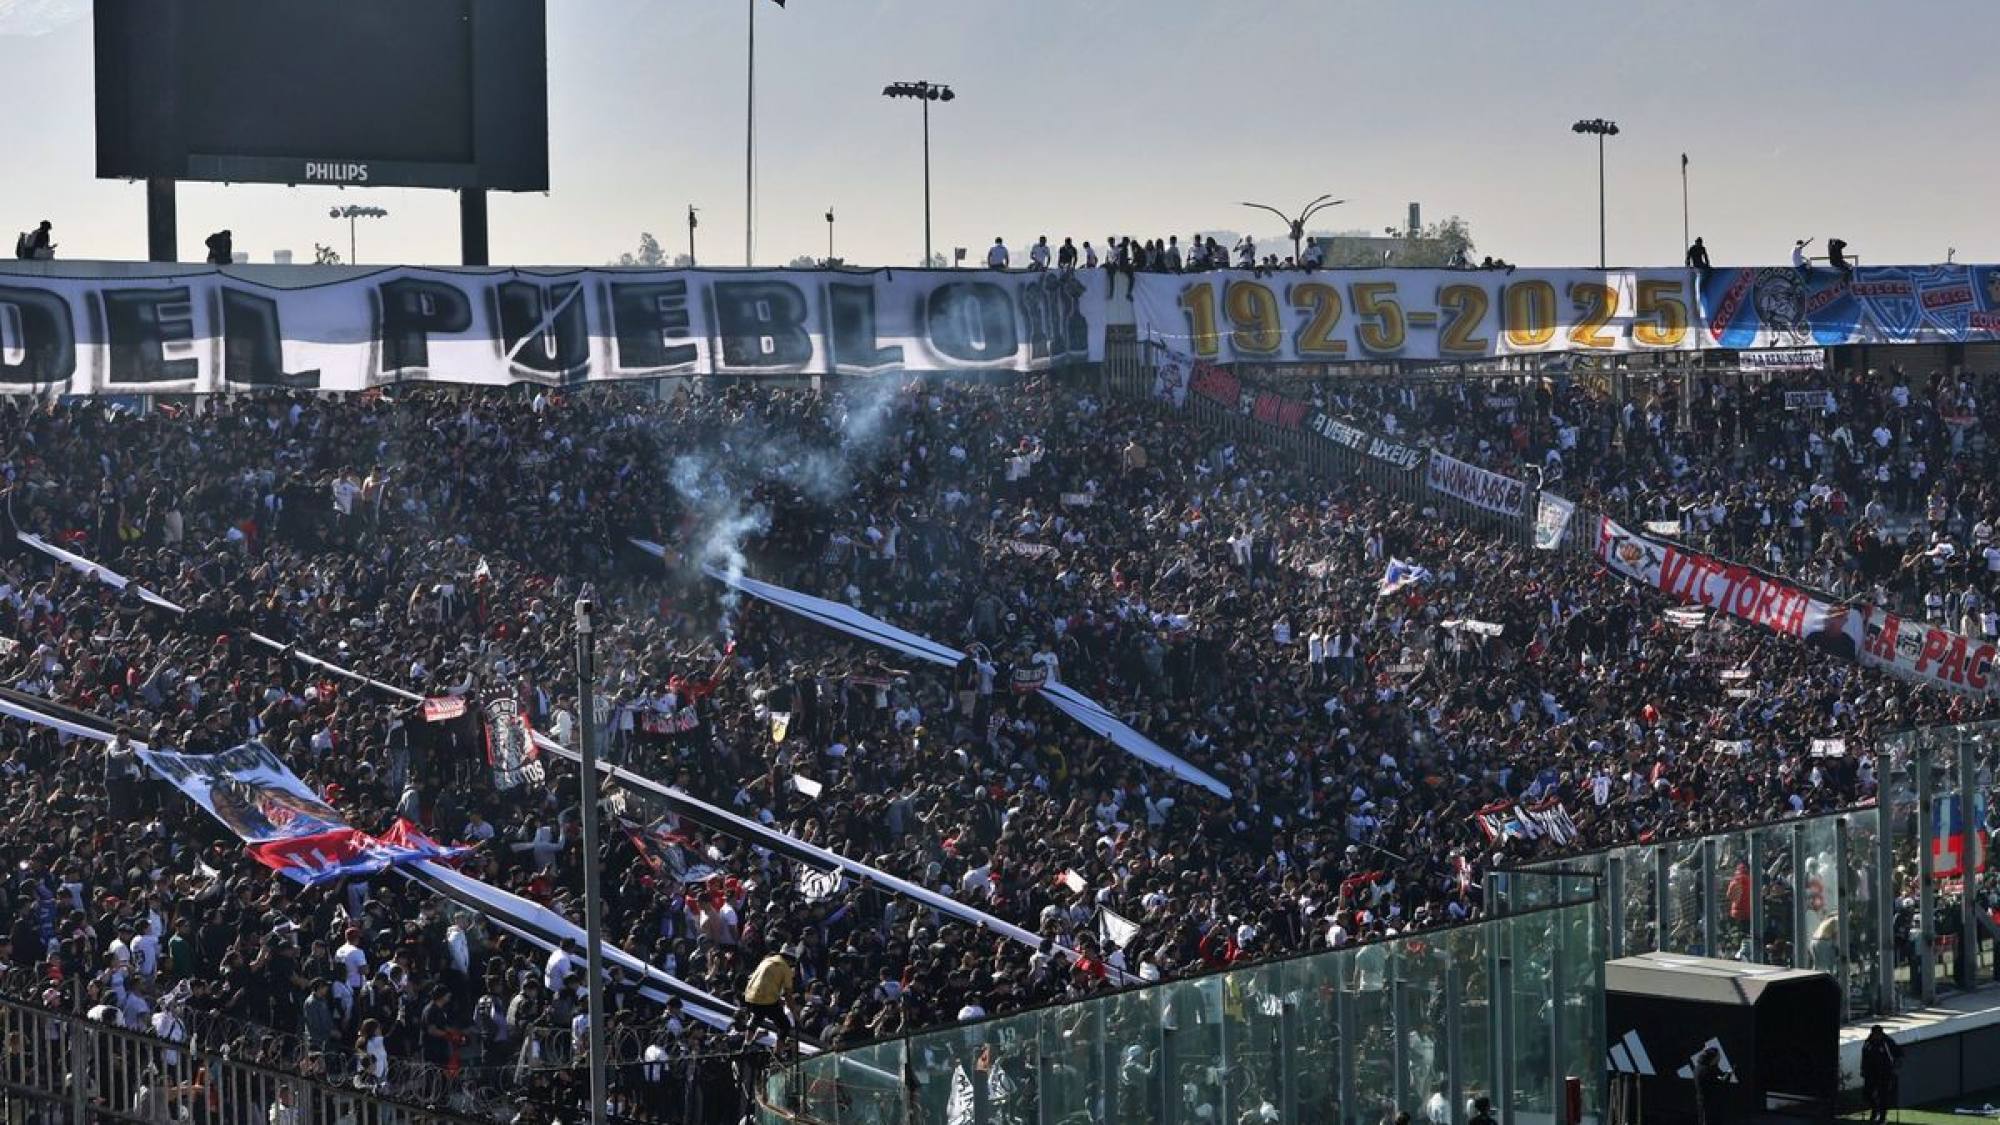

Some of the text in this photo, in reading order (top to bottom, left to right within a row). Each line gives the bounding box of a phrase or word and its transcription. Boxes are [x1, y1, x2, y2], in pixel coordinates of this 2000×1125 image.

[305, 162, 368, 181] PHILIPS
[0, 276, 1020, 391] DEL PUEBLO
[1182, 279, 1690, 356] 1925-2025
[1658, 545, 1810, 640] VICTORIA
